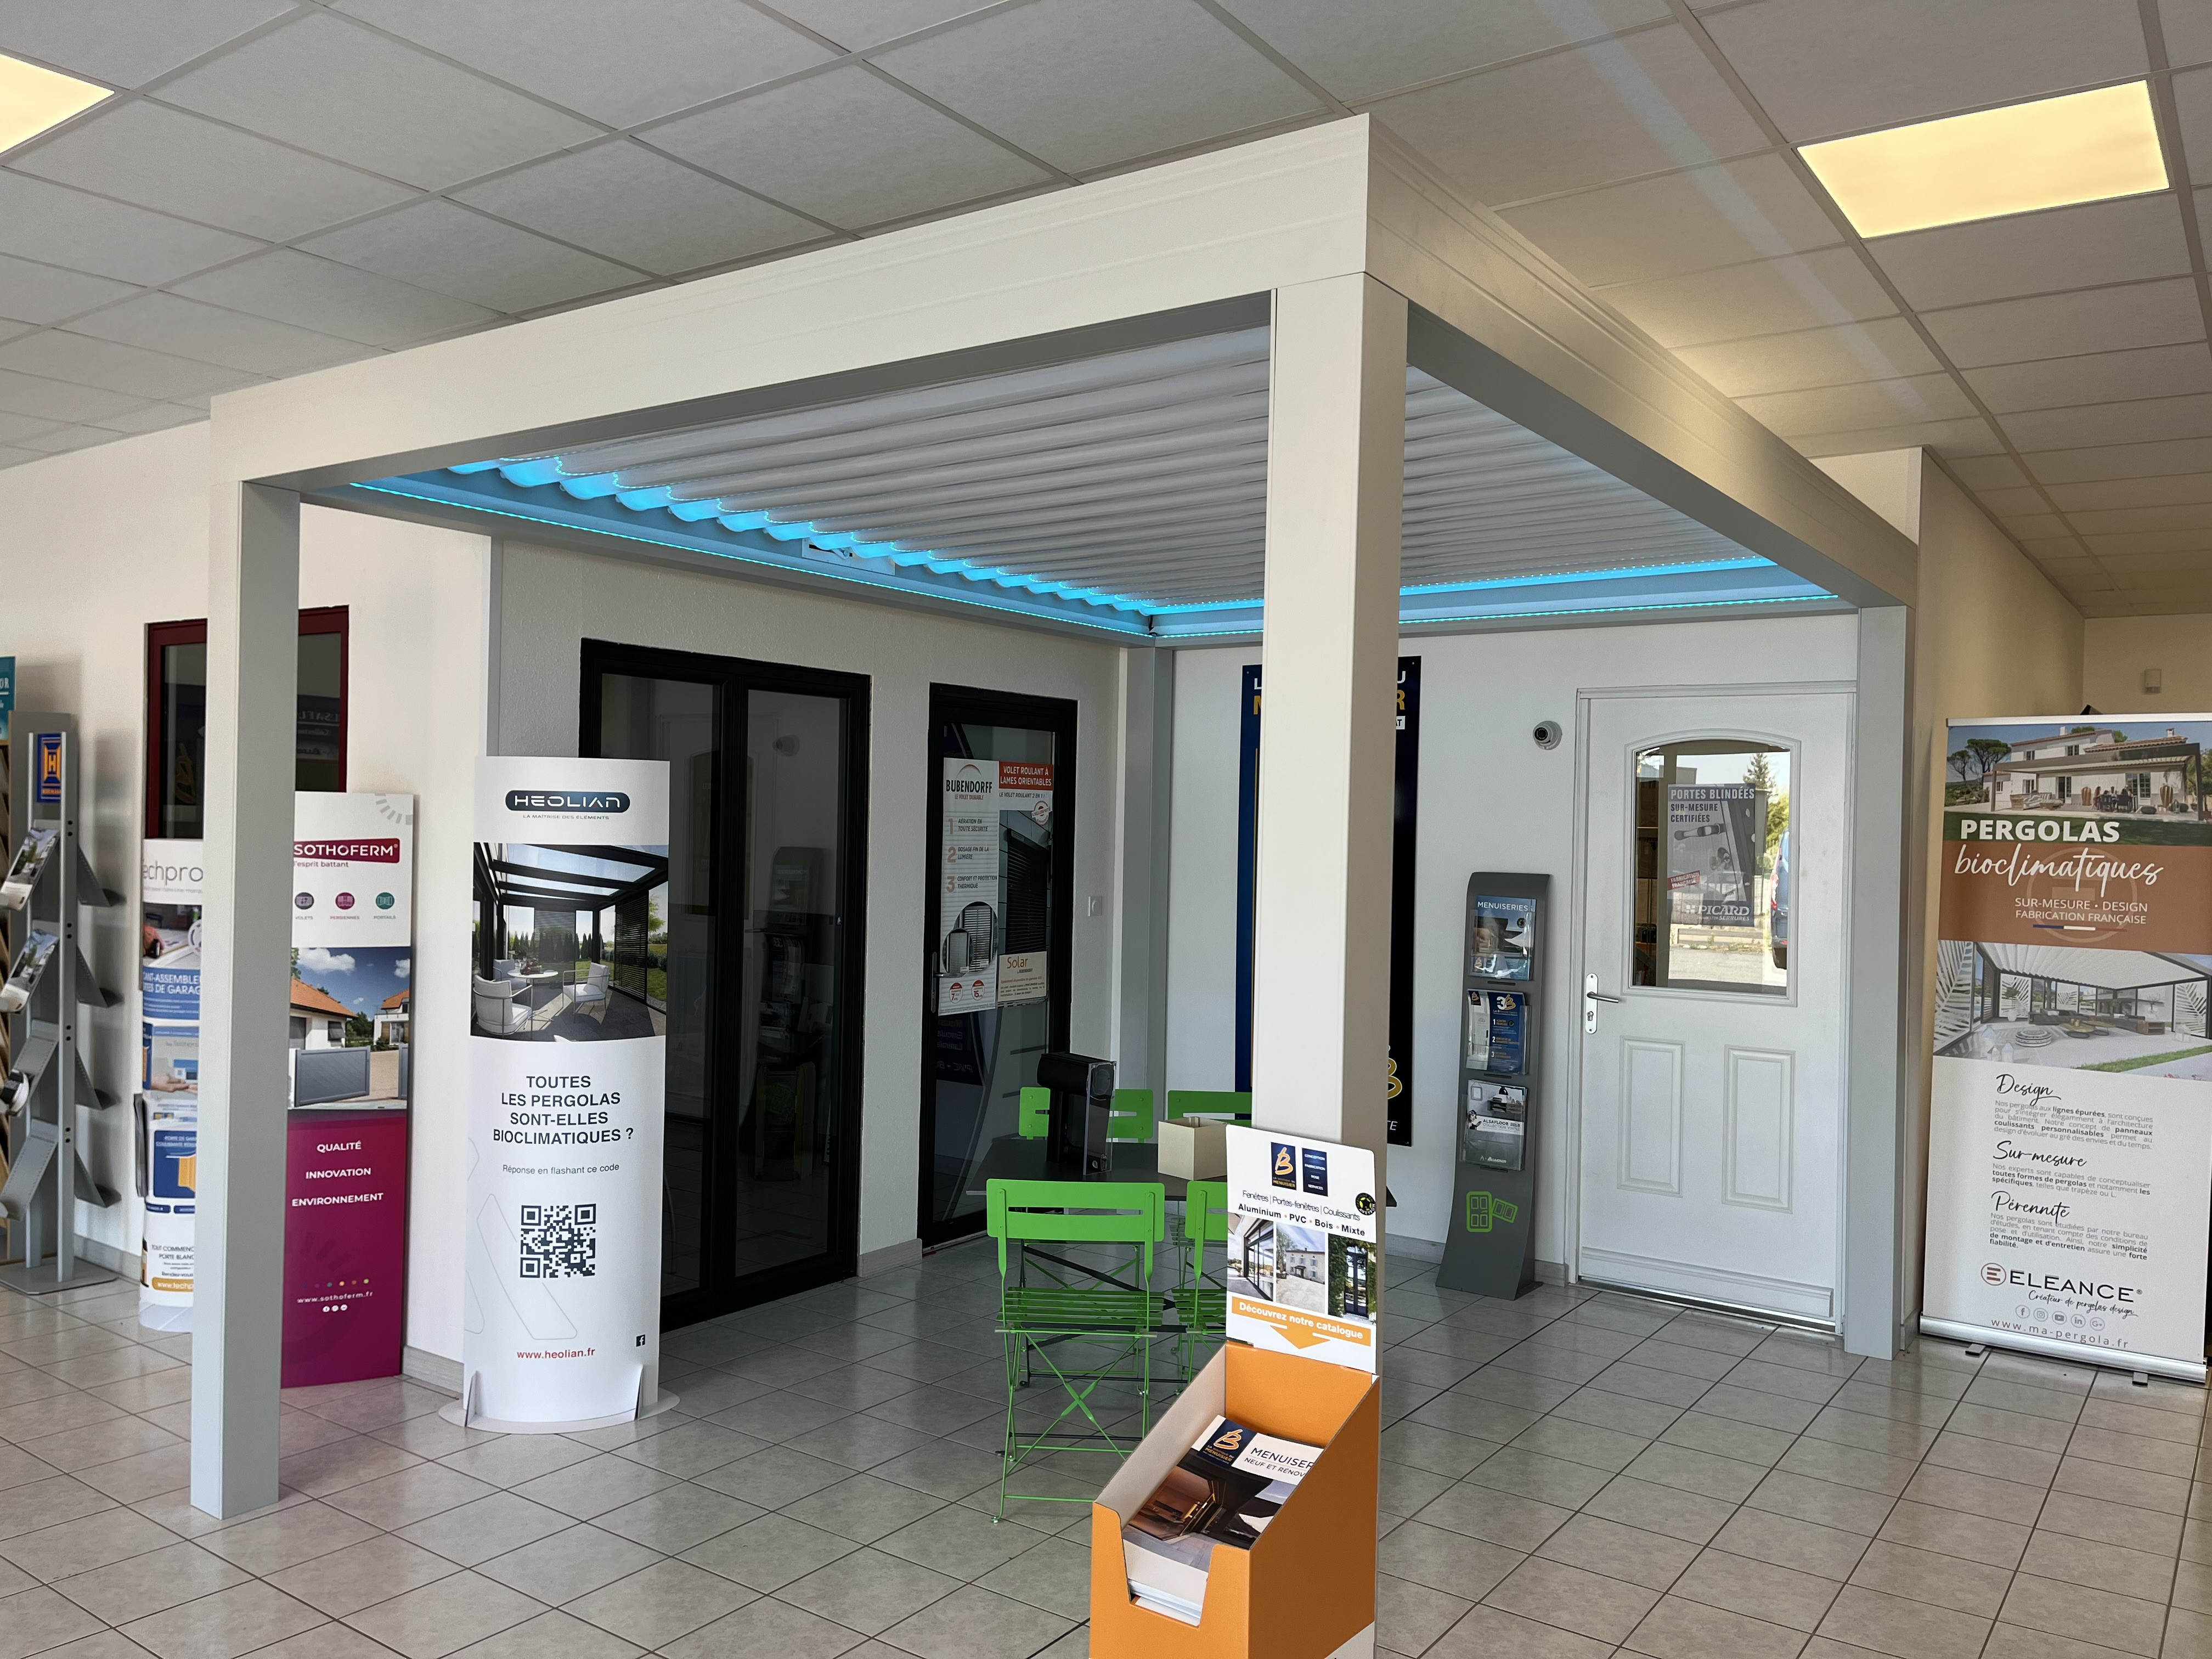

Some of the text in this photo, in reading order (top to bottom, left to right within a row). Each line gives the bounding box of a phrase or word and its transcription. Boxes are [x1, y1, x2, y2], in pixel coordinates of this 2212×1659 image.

[1003, 766, 1048, 776] VOLET ROULANT À
[946, 780, 992, 793] BUBENDORFF
[1000, 776, 1052, 786] LAMES ORIENTABLES
[1671, 786, 1754, 799] PORTES BLINDÉES
[515, 795, 620, 808] HEOLIAN
[1671, 803, 1718, 811] SUR-MESURE
[1671, 812, 1710, 822] CERTIFIÉES
[948, 818, 953, 834] 1
[1961, 820, 2120, 842] PERGOLAS
[294, 844, 393, 856] SOTHOFERM
[947, 847, 956, 862] 2
[1671, 872, 1700, 883] FABRICATION
[1954, 843, 2164, 898] bioclimatiques
[946, 876, 955, 893] 3
[1477, 901, 1528, 911] MENUISERIES
[1698, 905, 1750, 916] PICARD
[2015, 898, 2147, 912] SUR-MESURE DESIGN
[2016, 910, 2146, 926] FABRICATION FRANÇAISE
[1007, 956, 1028, 969] Solar
[167, 985, 201, 996] GARAG
[951, 993, 955, 1001] 7
[526, 1076, 591, 1088] TOUTES
[1996, 1074, 2061, 1106] Design
[501, 1092, 620, 1107] LES PERGOLAS
[510, 1111, 608, 1125] SONT-ELLES
[2051, 1113, 2095, 1123] élégamment
[2052, 1106, 2074, 1114] lignes
[2124, 1115, 2153, 1123] conçues
[493, 1127, 634, 1144] BIOCLIMATIQUES ?
[1994, 1120, 2034, 1130] coulissants
[2041, 1126, 2104, 1137] personnalisables
[1994, 1126, 2016, 1135] design
[2069, 1122, 2097, 1131] concept
[2115, 1127, 2153, 1136] panneaux
[317, 1141, 362, 1153] QUALITÉ
[1993, 1140, 2087, 1167] Sur-mesure
[306, 1167, 371, 1179] INNOVATION
[503, 1164, 535, 1175] Réponse
[551, 1166, 585, 1175] flashant
[600, 1163, 619, 1172] code
[2017, 1172, 2042, 1181] formes
[2055, 1178, 2087, 1187] pergolas
[2097, 1184, 2137, 1193] notamment
[2054, 1171, 2085, 1180] capables
[2099, 1177, 2150, 1188] conceptualiser
[291, 1193, 383, 1207] ENVIRONNEMENT
[1242, 1190, 1361, 1221] Fenêtres Portes-fenêtres Coulissants
[1991, 1190, 2070, 1224] Pérennité
[1238, 1203, 1365, 1236] Aluminium PVC Bois Mixte
[2006, 1215, 2148, 1239] pergolas bureau
[1990, 1238, 2018, 1249] fiabilité.
[2101, 1235, 2136, 1245] conditions
[2001, 1235, 2033, 1244] montage
[2045, 1240, 2085, 1251] d'entretien
[2129, 1252, 2147, 1261] forte
[2112, 1243, 2148, 1254] simplicité
[2010, 1269, 2134, 1303] ELEANCE
[297, 1291, 373, 1304] www.sothoferm.fr
[2028, 1290, 2063, 1305] Créateur
[2076, 1301, 2108, 1314] pergolas
[2109, 1304, 2139, 1319] design
[1239, 1301, 1363, 1340] Découvrez notre catalogue
[1991, 1319, 2129, 1348] www.ma-pergola.fr
[517, 1347, 595, 1359] www.heolian.fr
[1205, 1447, 1232, 1462] MENUISIER
[1251, 1447, 1314, 1469] MENUISER
[1244, 1457, 1266, 1466] NEUF
[1278, 1466, 1306, 1477] RÉNOV
